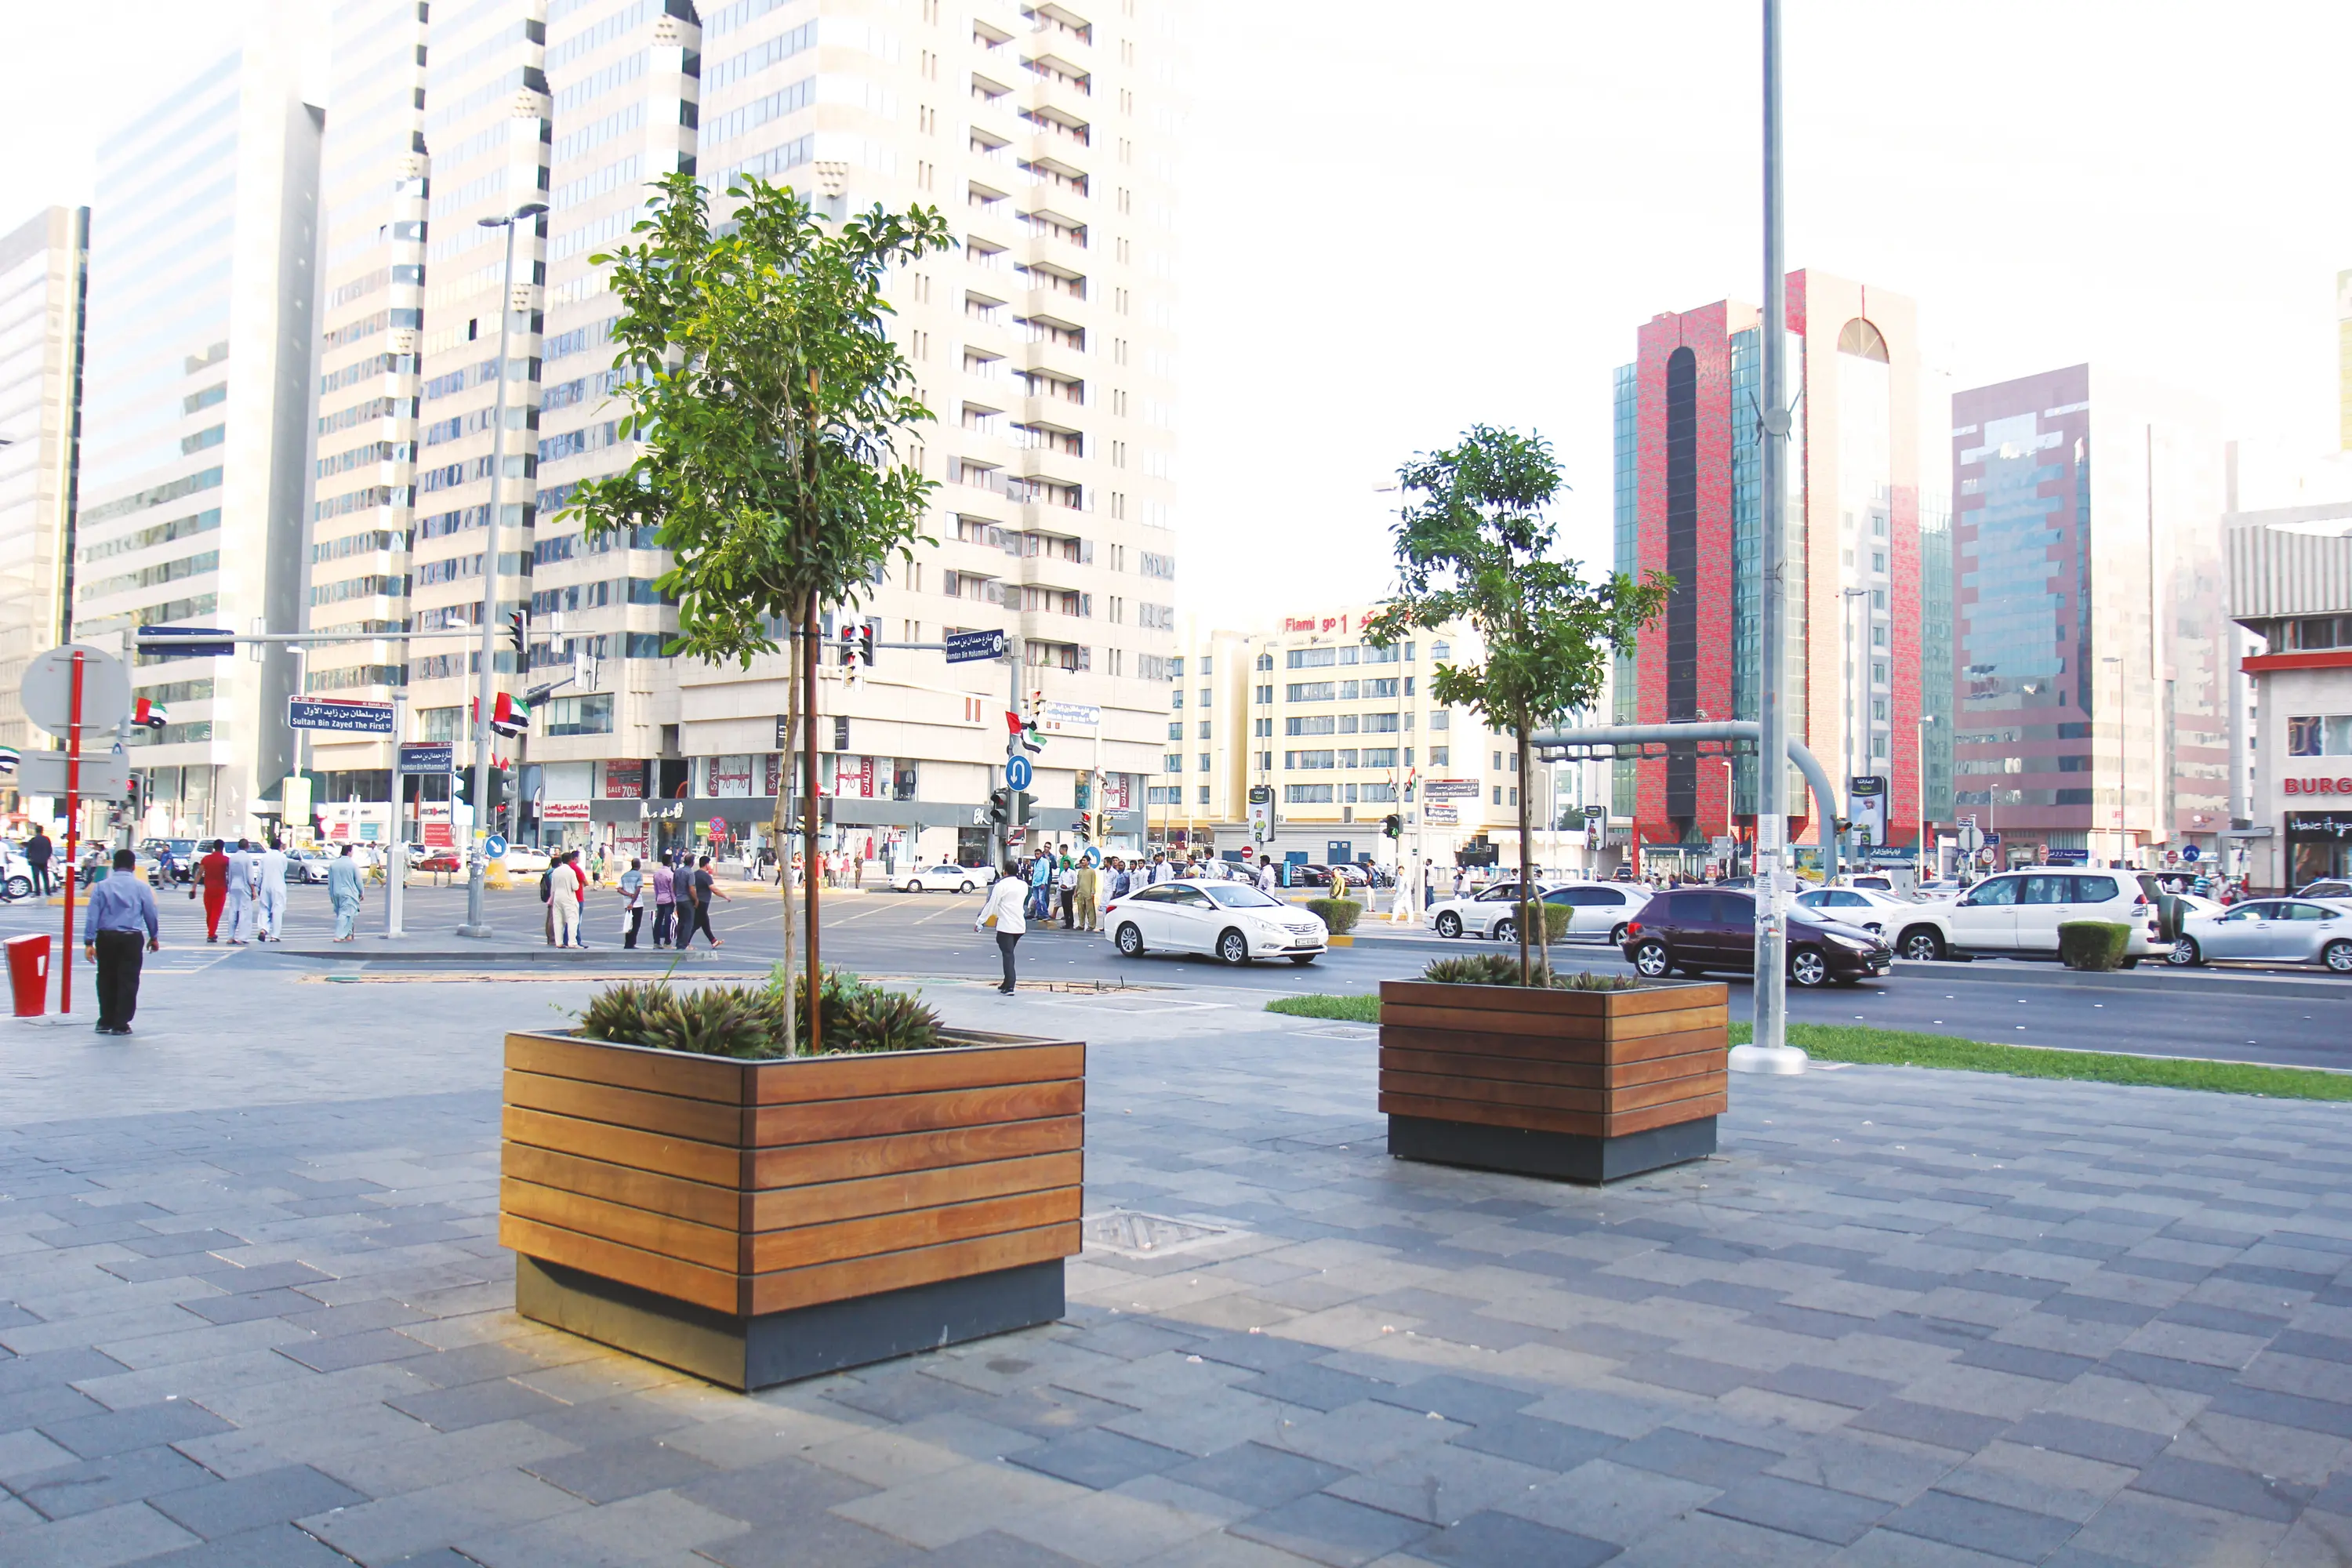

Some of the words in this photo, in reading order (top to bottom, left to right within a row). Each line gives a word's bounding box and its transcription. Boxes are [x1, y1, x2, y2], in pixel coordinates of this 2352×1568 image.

[960, 637, 967, 648] بن
[967, 637, 982, 646] حمدان
[982, 633, 993, 647] شارع
[303, 705, 323, 716] الأول
[324, 708, 339, 717] زايد
[339, 710, 350, 719] بن
[350, 709, 374, 718] سلطان
[375, 711, 392, 721] شارع
[292, 717, 315, 726] Sultan
[332, 720, 353, 729] Zayed
[768, 761, 777, 789] SALE
[2290, 818, 2322, 831] Have
[2323, 816, 2334, 832] it
